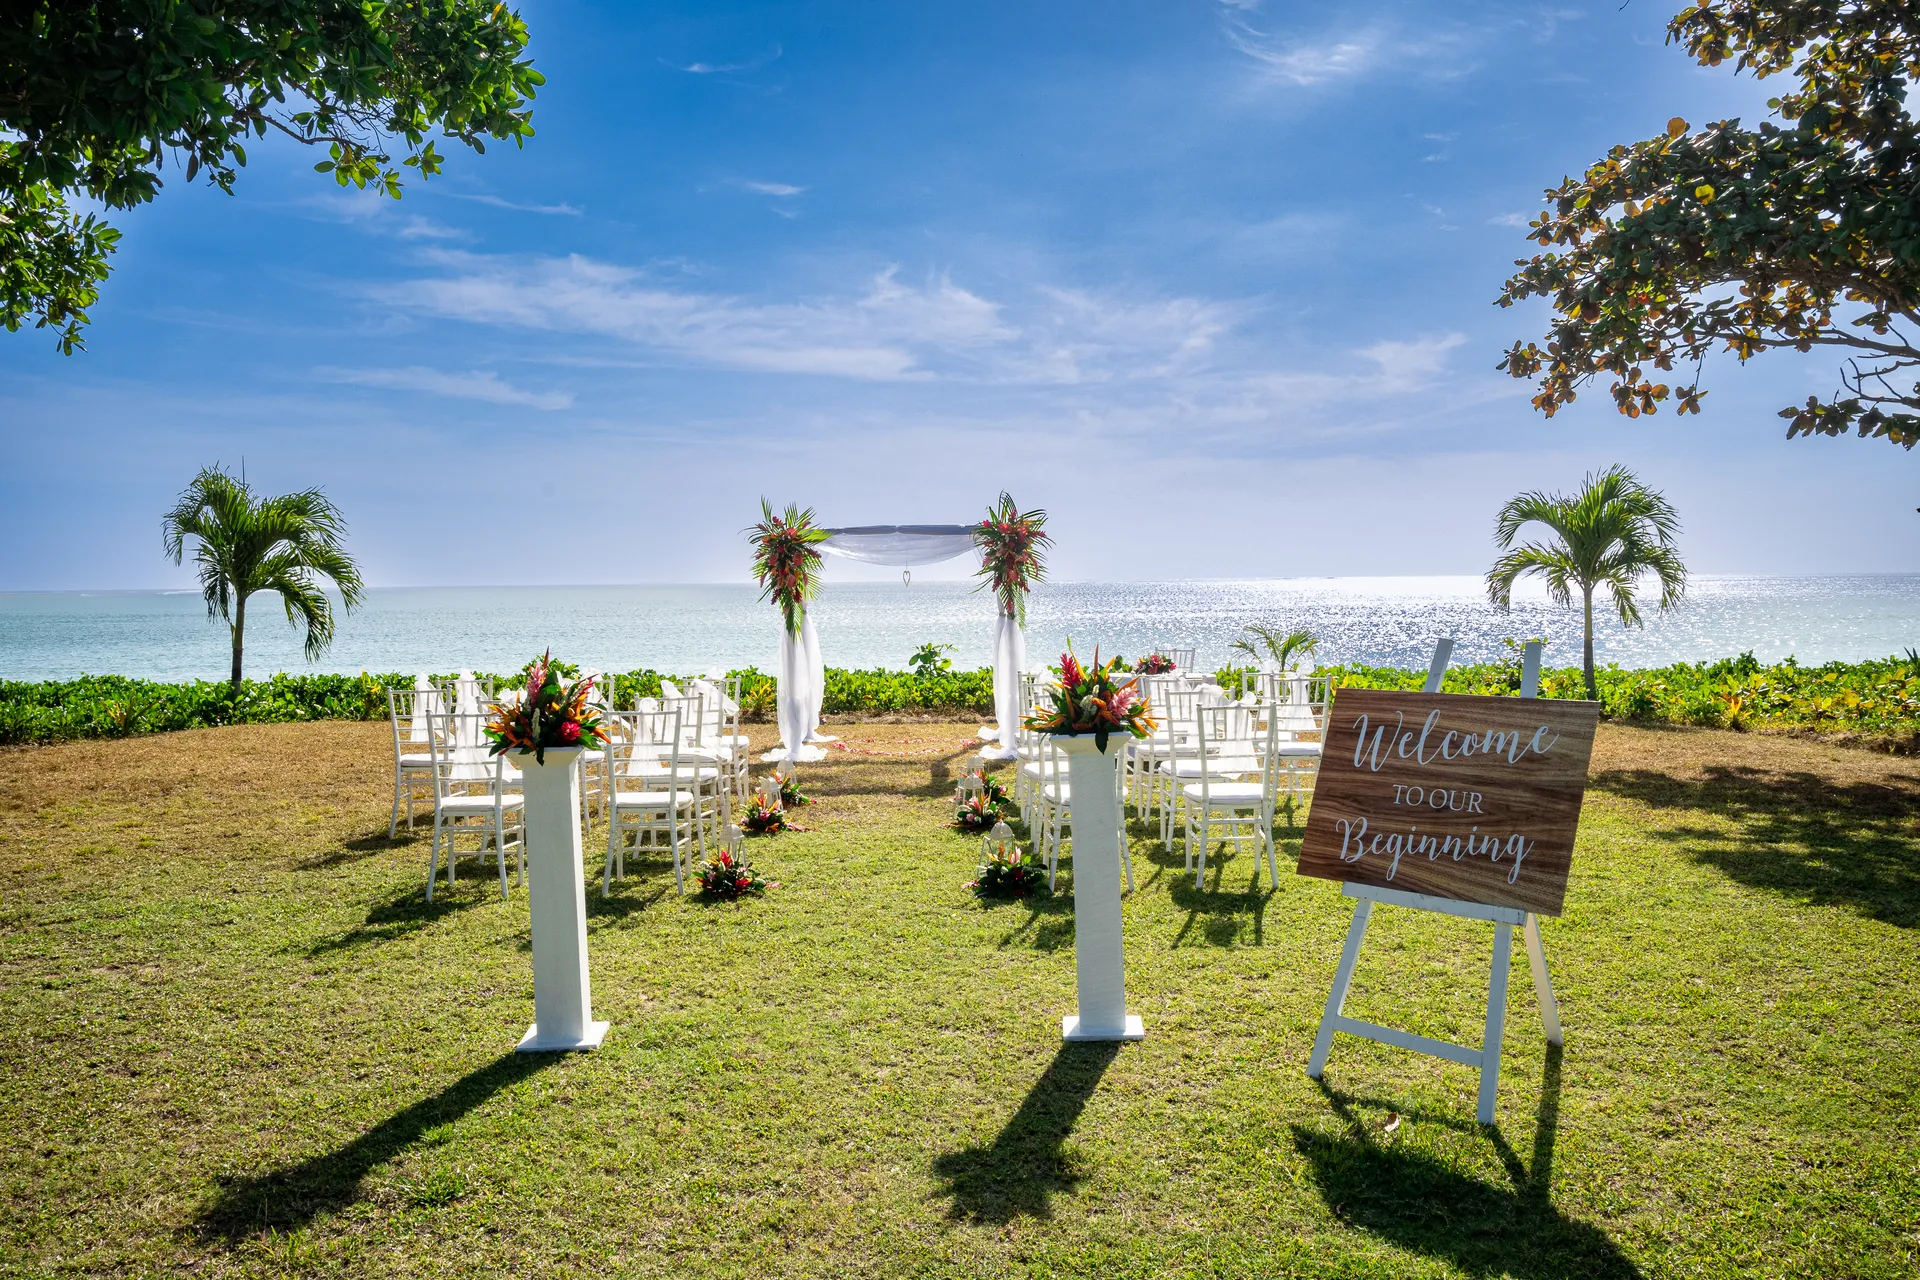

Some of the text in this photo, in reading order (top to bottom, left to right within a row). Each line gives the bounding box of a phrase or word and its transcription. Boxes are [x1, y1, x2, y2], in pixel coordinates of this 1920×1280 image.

[1352, 709, 1560, 772] Welcome
[1392, 784, 1484, 814] TO OUR
[1335, 816, 1535, 885] Beginning
